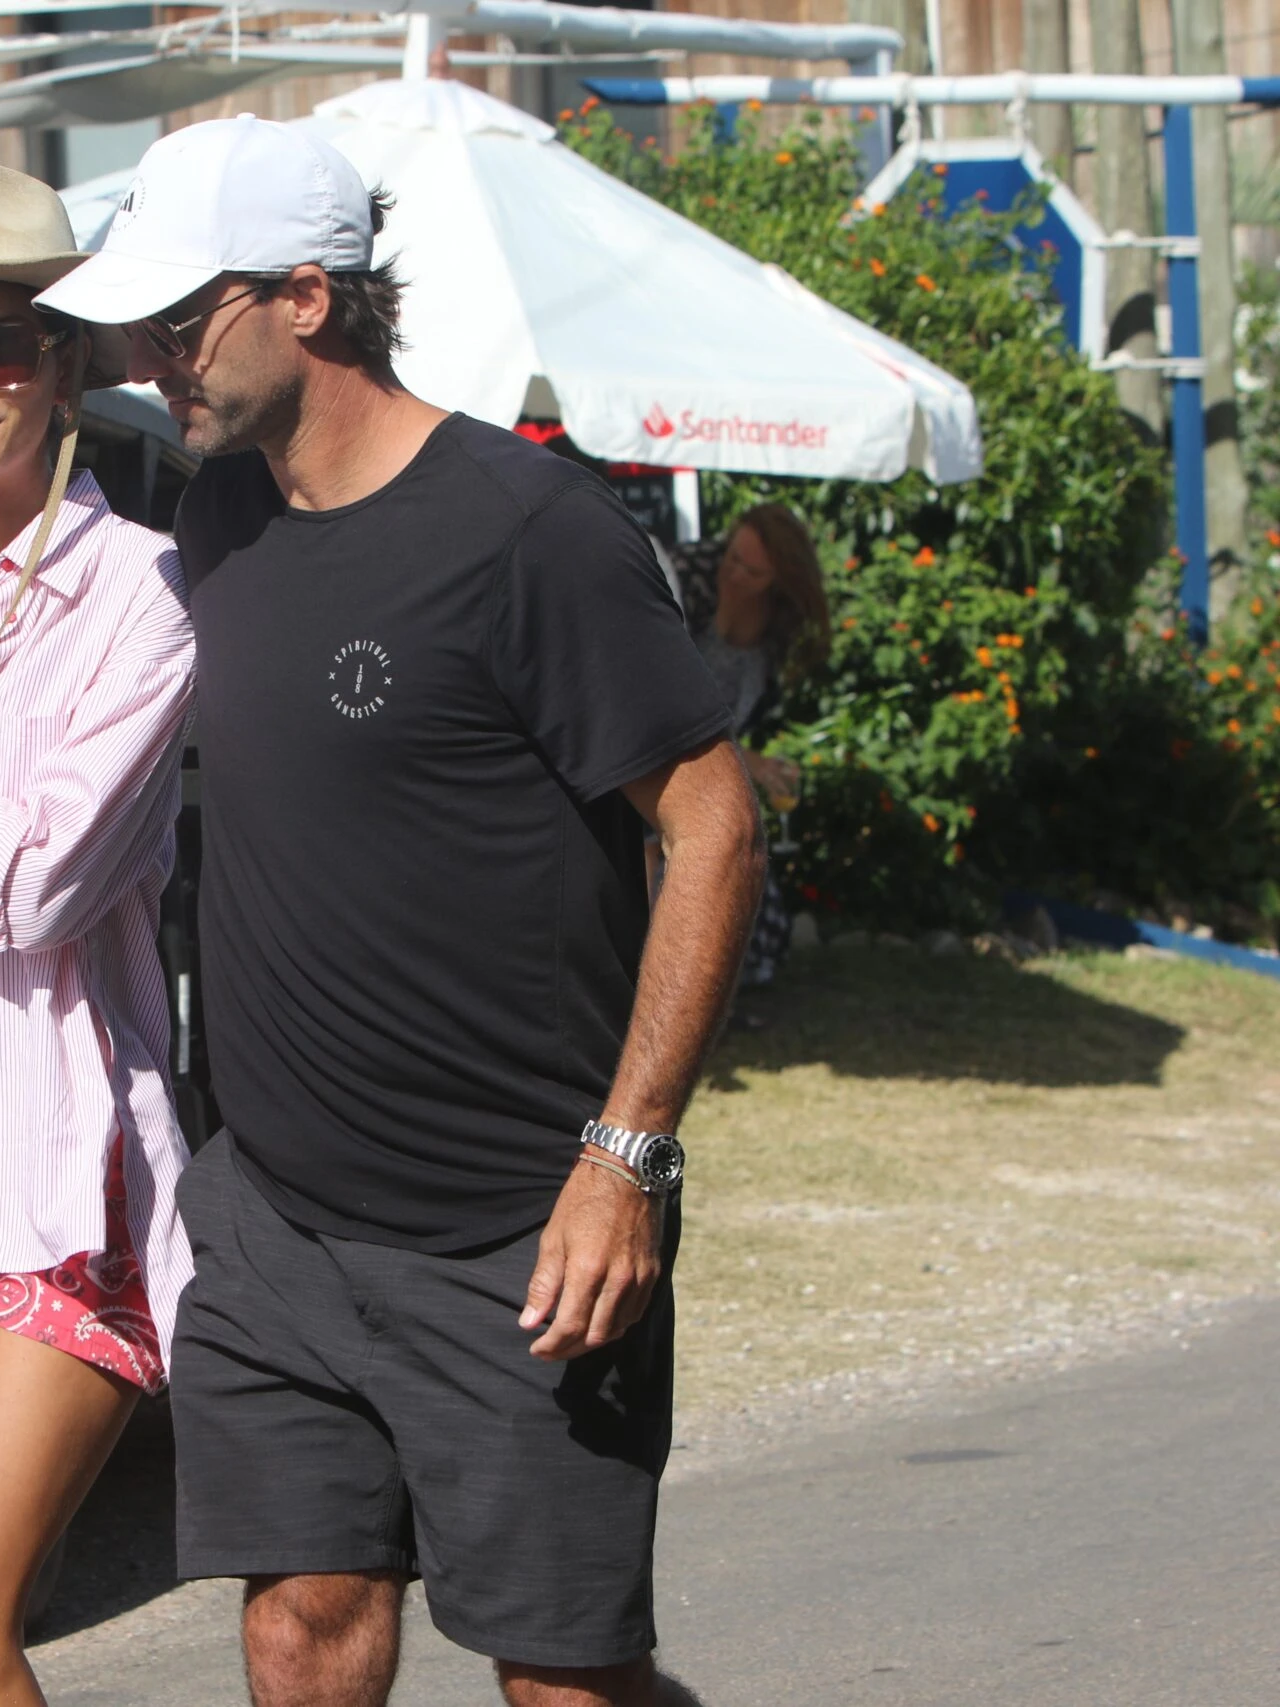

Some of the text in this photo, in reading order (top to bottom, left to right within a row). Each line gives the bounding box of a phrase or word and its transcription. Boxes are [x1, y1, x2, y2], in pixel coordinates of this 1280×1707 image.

[680, 409, 830, 448] Santander
[334, 639, 391, 668] SPIRITUAL
[331, 693, 384, 719] GANGSTER
